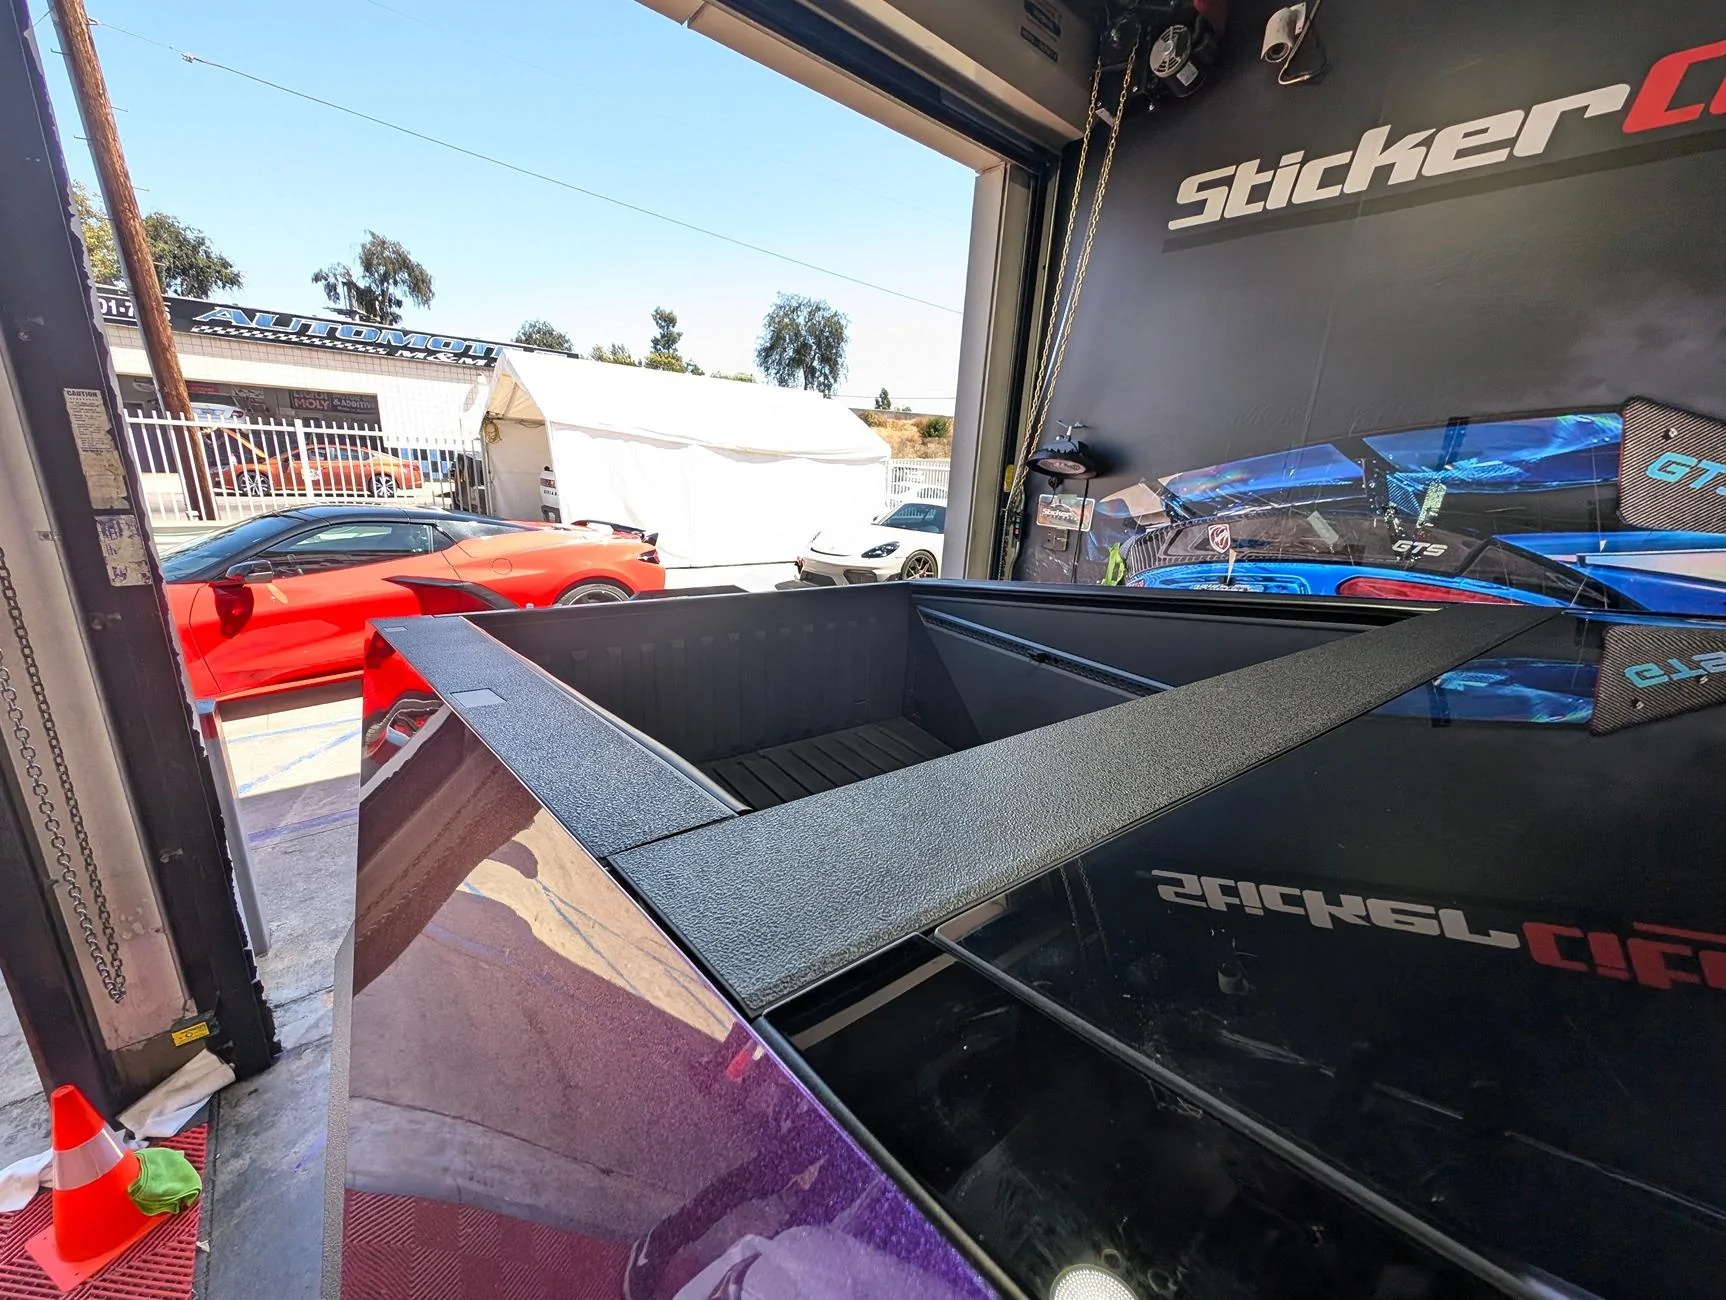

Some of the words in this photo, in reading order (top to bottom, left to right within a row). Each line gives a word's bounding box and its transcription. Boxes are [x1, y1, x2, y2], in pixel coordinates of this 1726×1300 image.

[1168, 39, 1726, 230] StickerC
[192, 306, 567, 357] AUTOMOTI
[66, 389, 98, 398] CAUTION
[294, 398, 330, 410] MOLY
[1646, 451, 1726, 496] GT
[1392, 539, 1448, 557] GTS
